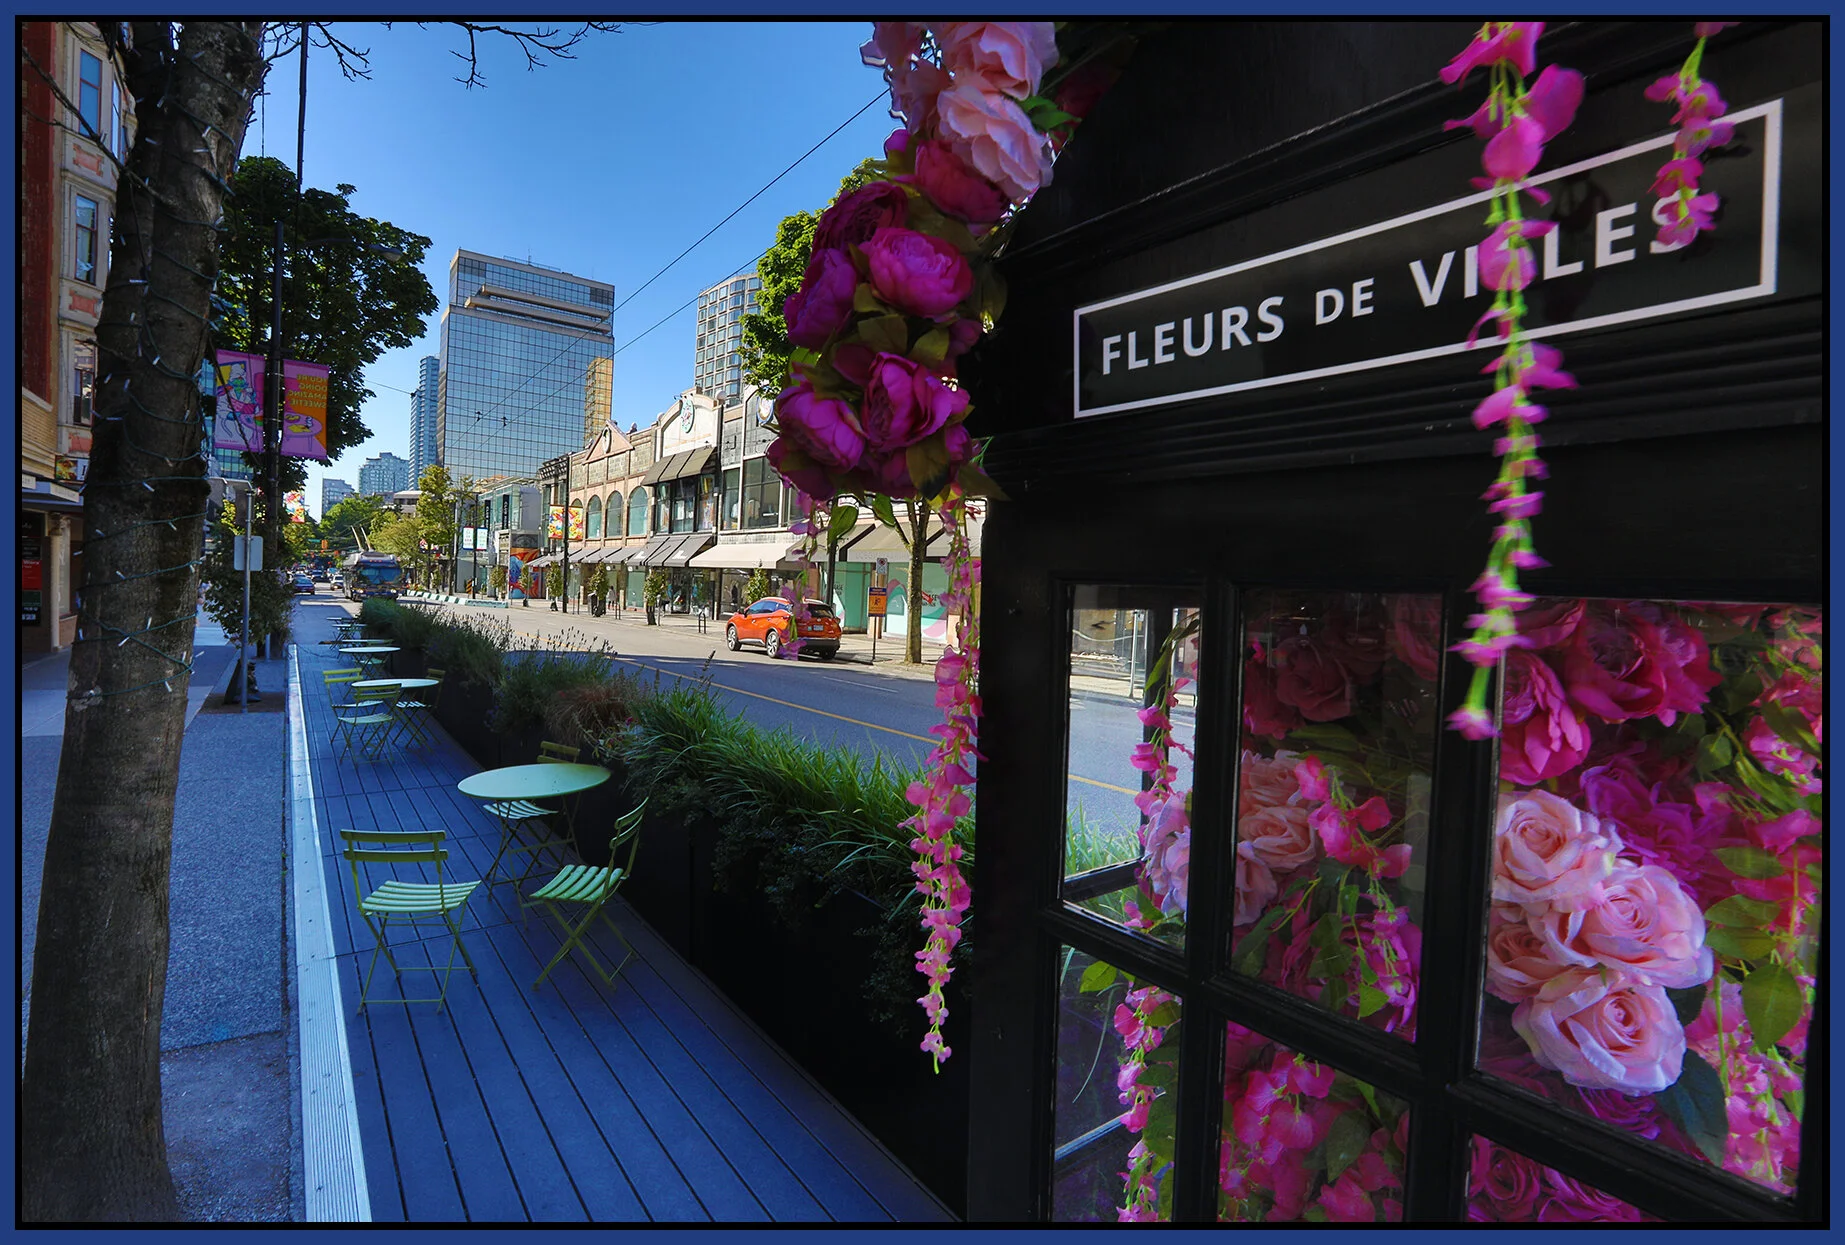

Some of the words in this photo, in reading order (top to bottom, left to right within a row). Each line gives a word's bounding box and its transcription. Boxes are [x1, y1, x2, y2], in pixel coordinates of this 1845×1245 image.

[1102, 295, 1285, 376] FLEURS
[1315, 277, 1375, 325] DE
[1408, 187, 1702, 308] VILES
